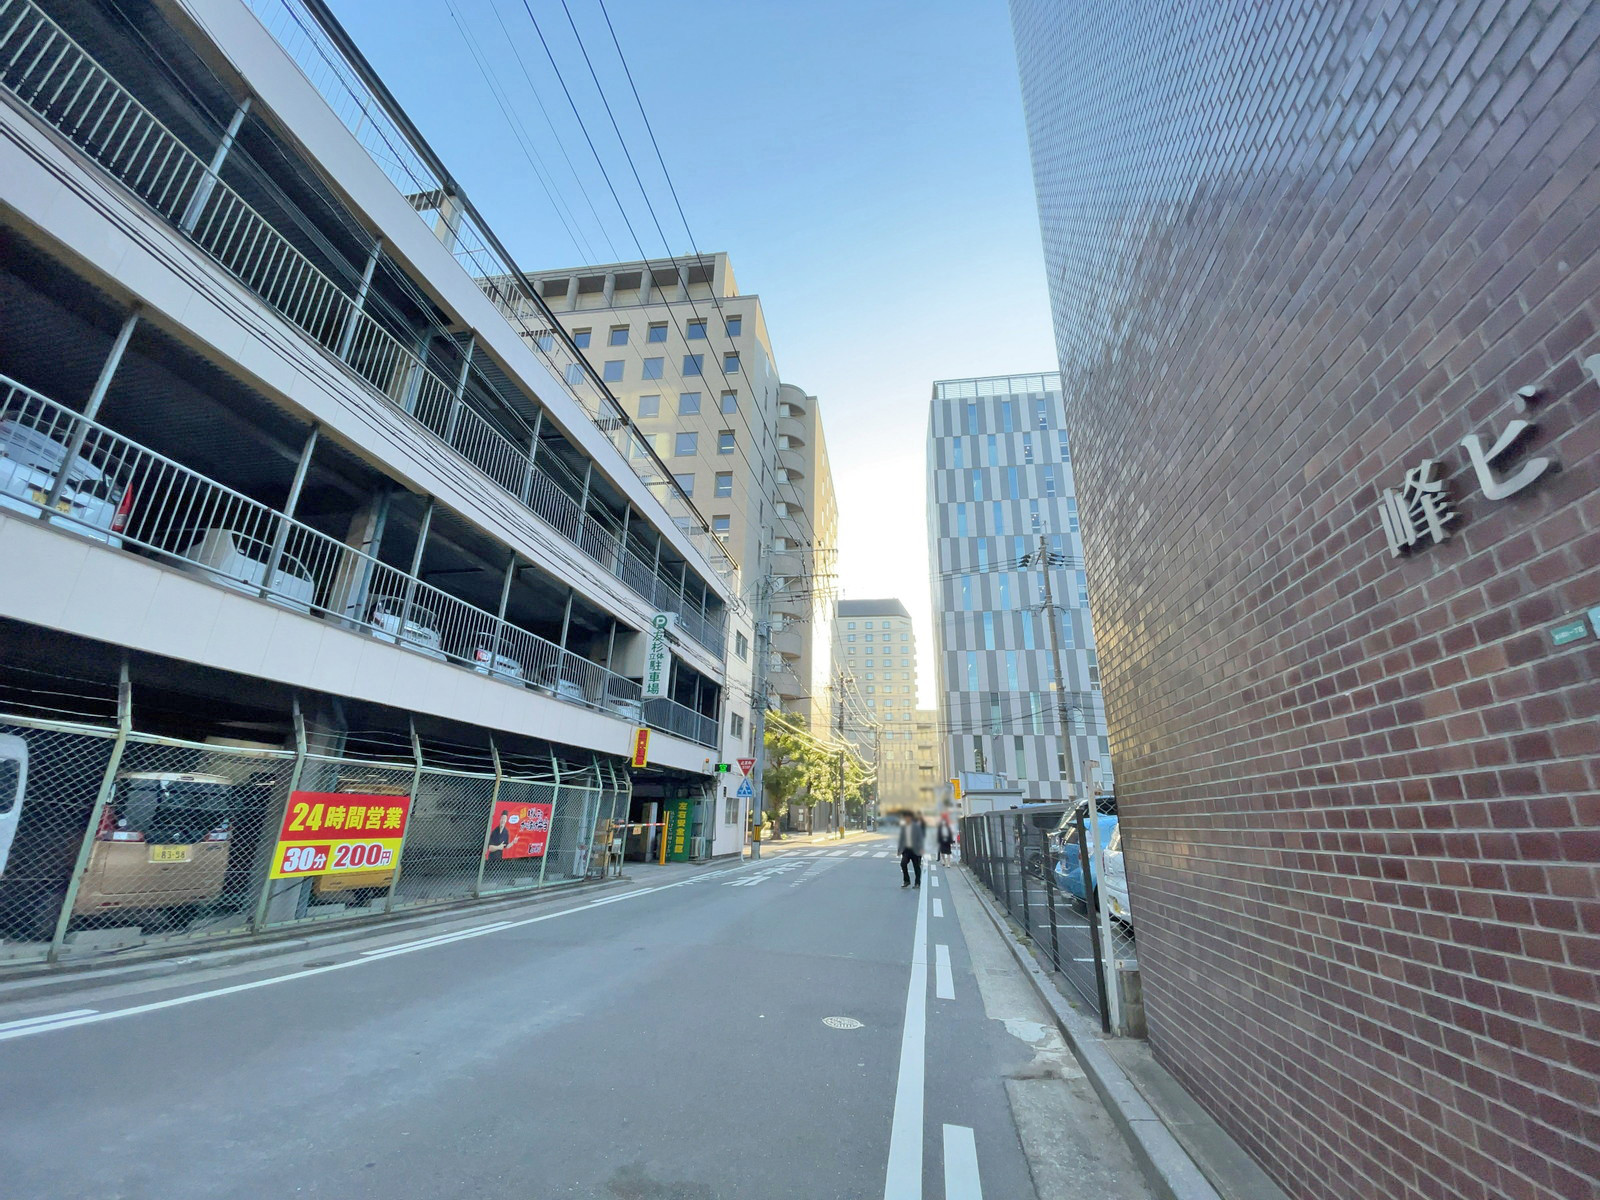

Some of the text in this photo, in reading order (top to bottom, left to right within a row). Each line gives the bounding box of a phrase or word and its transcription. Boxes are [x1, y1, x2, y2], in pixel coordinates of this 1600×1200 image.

[1379, 354, 1600, 558] 峰ビ
[288, 802, 403, 832] 24時間営業
[283, 842, 393, 872] 30分 200円
